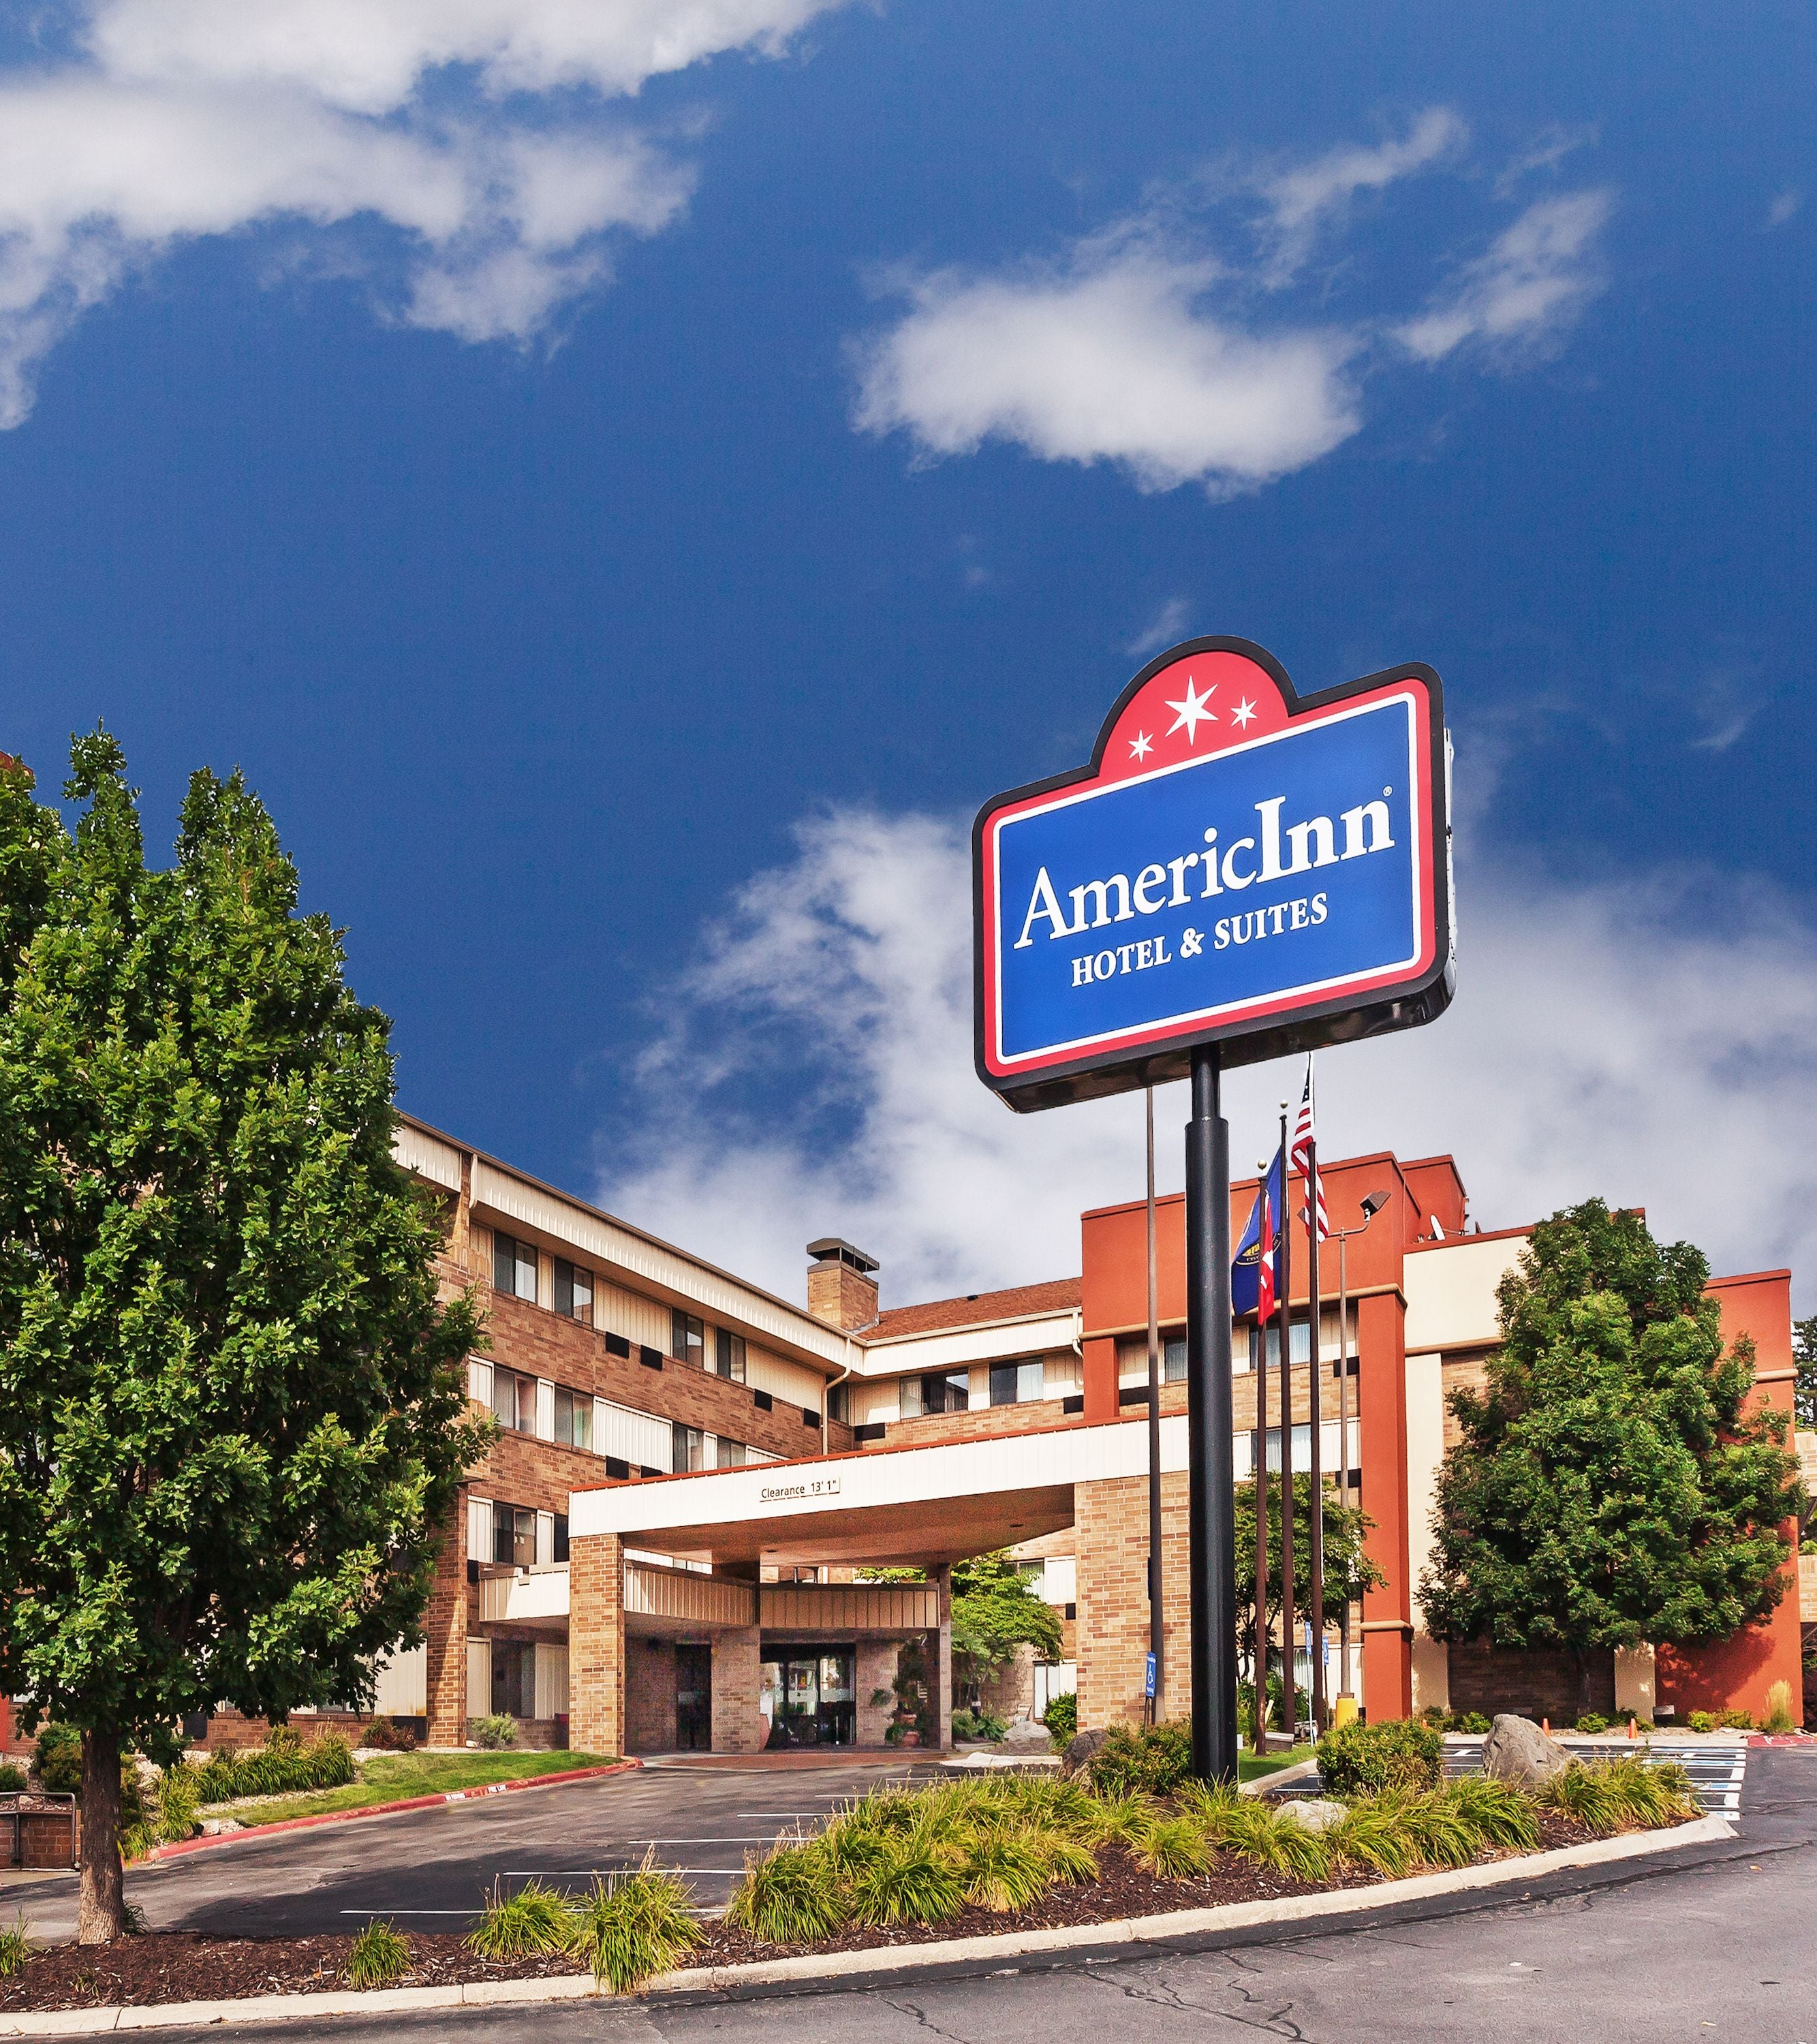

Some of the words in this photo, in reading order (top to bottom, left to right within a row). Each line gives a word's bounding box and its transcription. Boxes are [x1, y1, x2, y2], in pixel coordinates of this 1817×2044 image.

[1071, 935, 1172, 987] HOTEL
[1180, 927, 1205, 959] &
[1213, 893, 1328, 950] SUITES
[761, 1485, 805, 1498] Clearance
[811, 1481, 824, 1492] 13'
[827, 1480, 837, 1490] 1"
